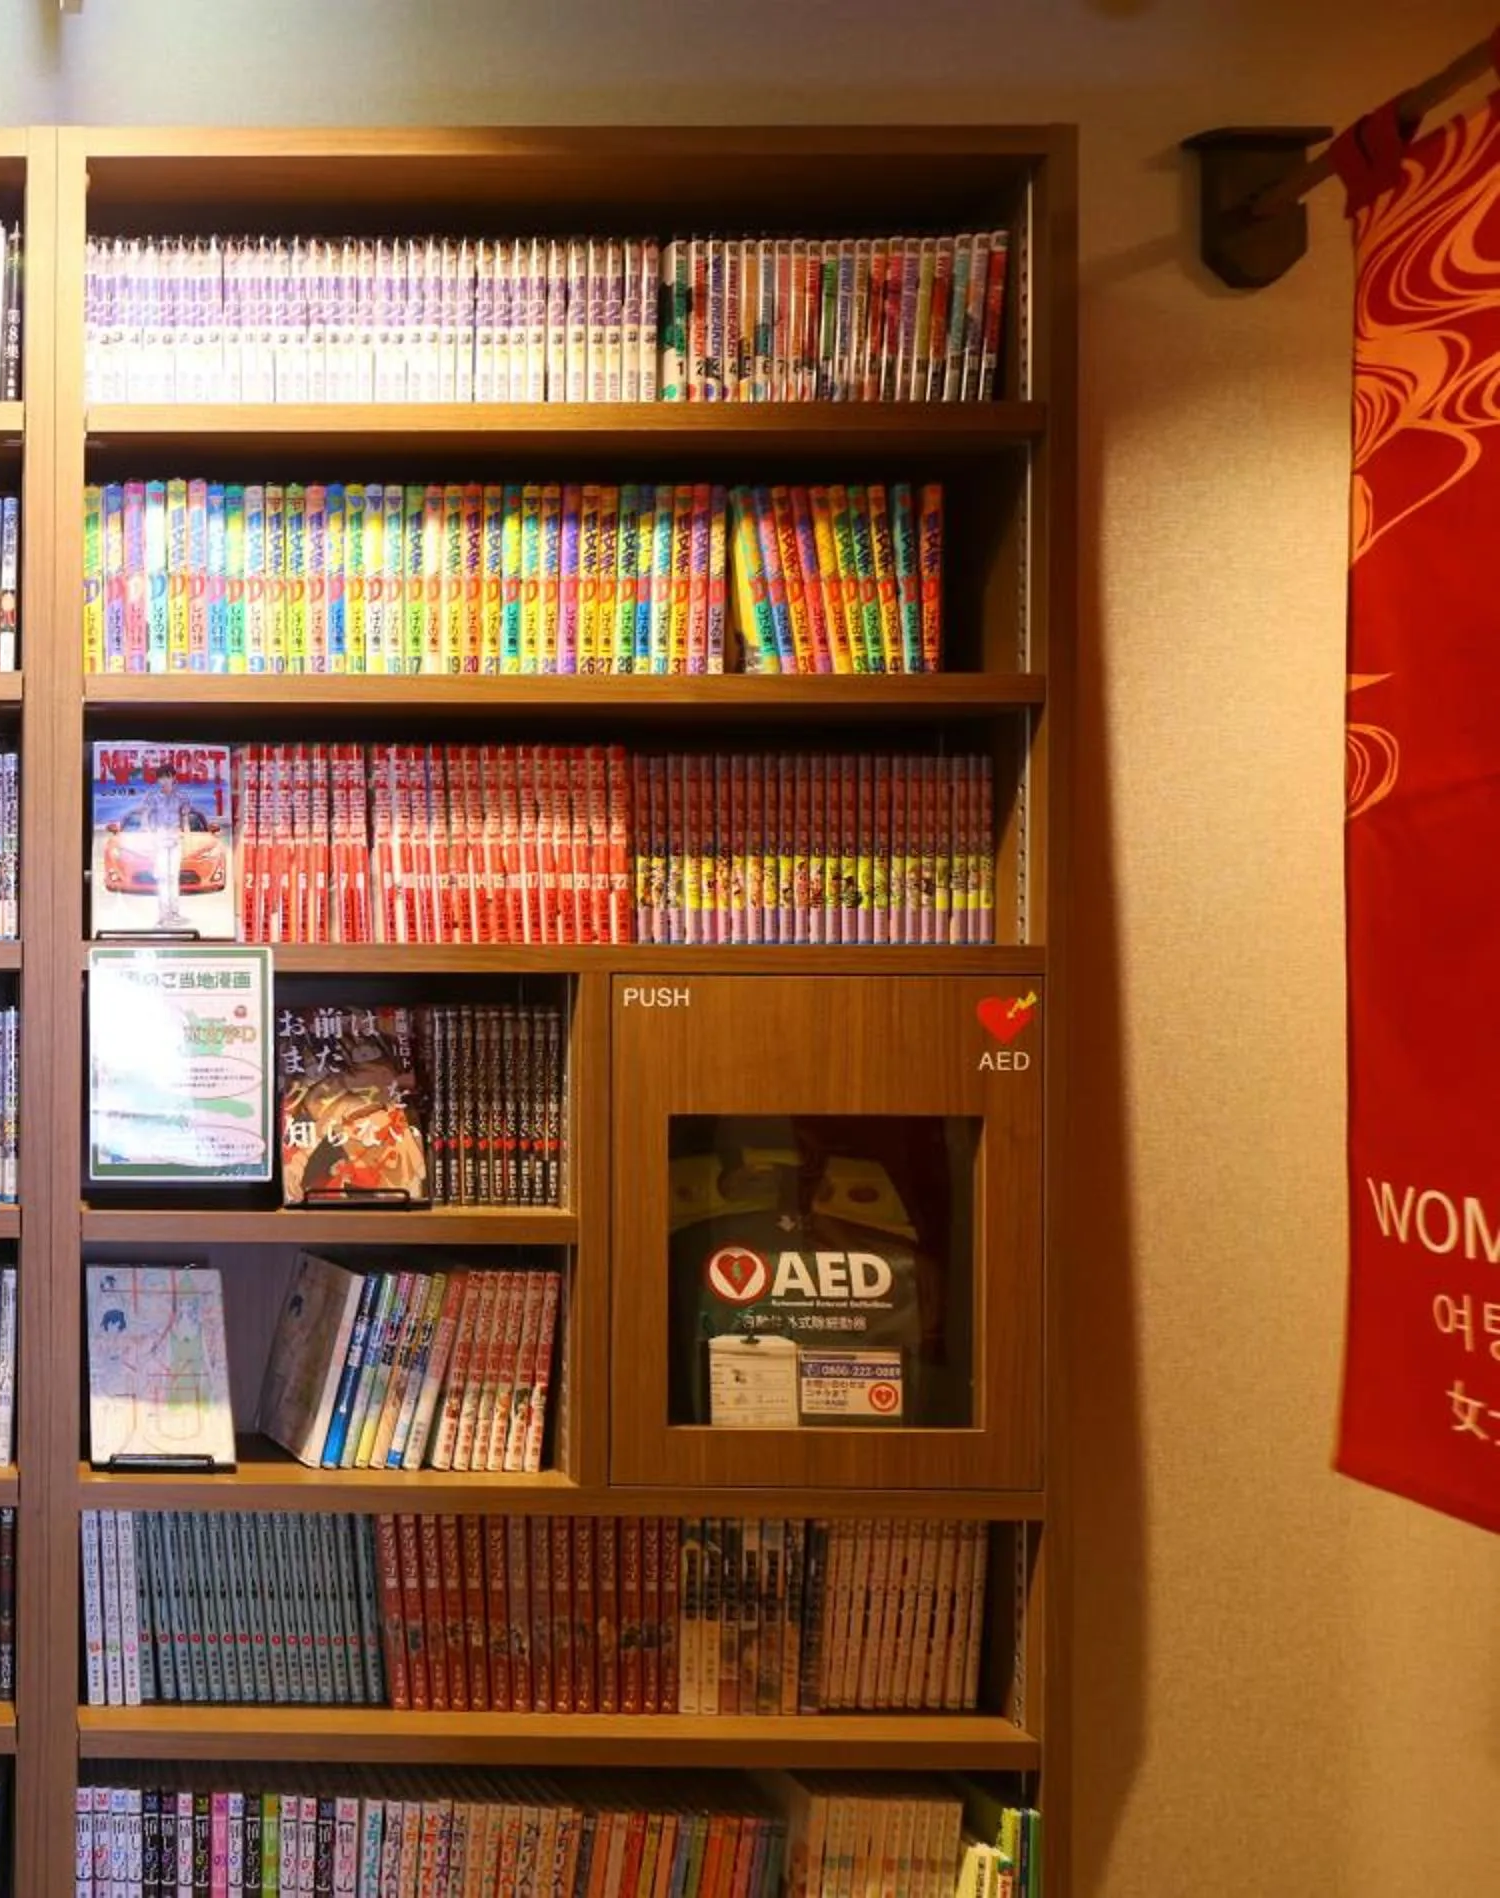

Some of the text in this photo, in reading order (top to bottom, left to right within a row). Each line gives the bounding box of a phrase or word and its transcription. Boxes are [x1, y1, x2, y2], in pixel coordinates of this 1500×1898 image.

[623, 987, 690, 1008] PUSH
[277, 1007, 381, 1039] お前は
[280, 1044, 344, 1074] まだ
[978, 1051, 1030, 1071] AED
[282, 1115, 422, 1148] 知らない
[770, 1250, 894, 1299] AED
